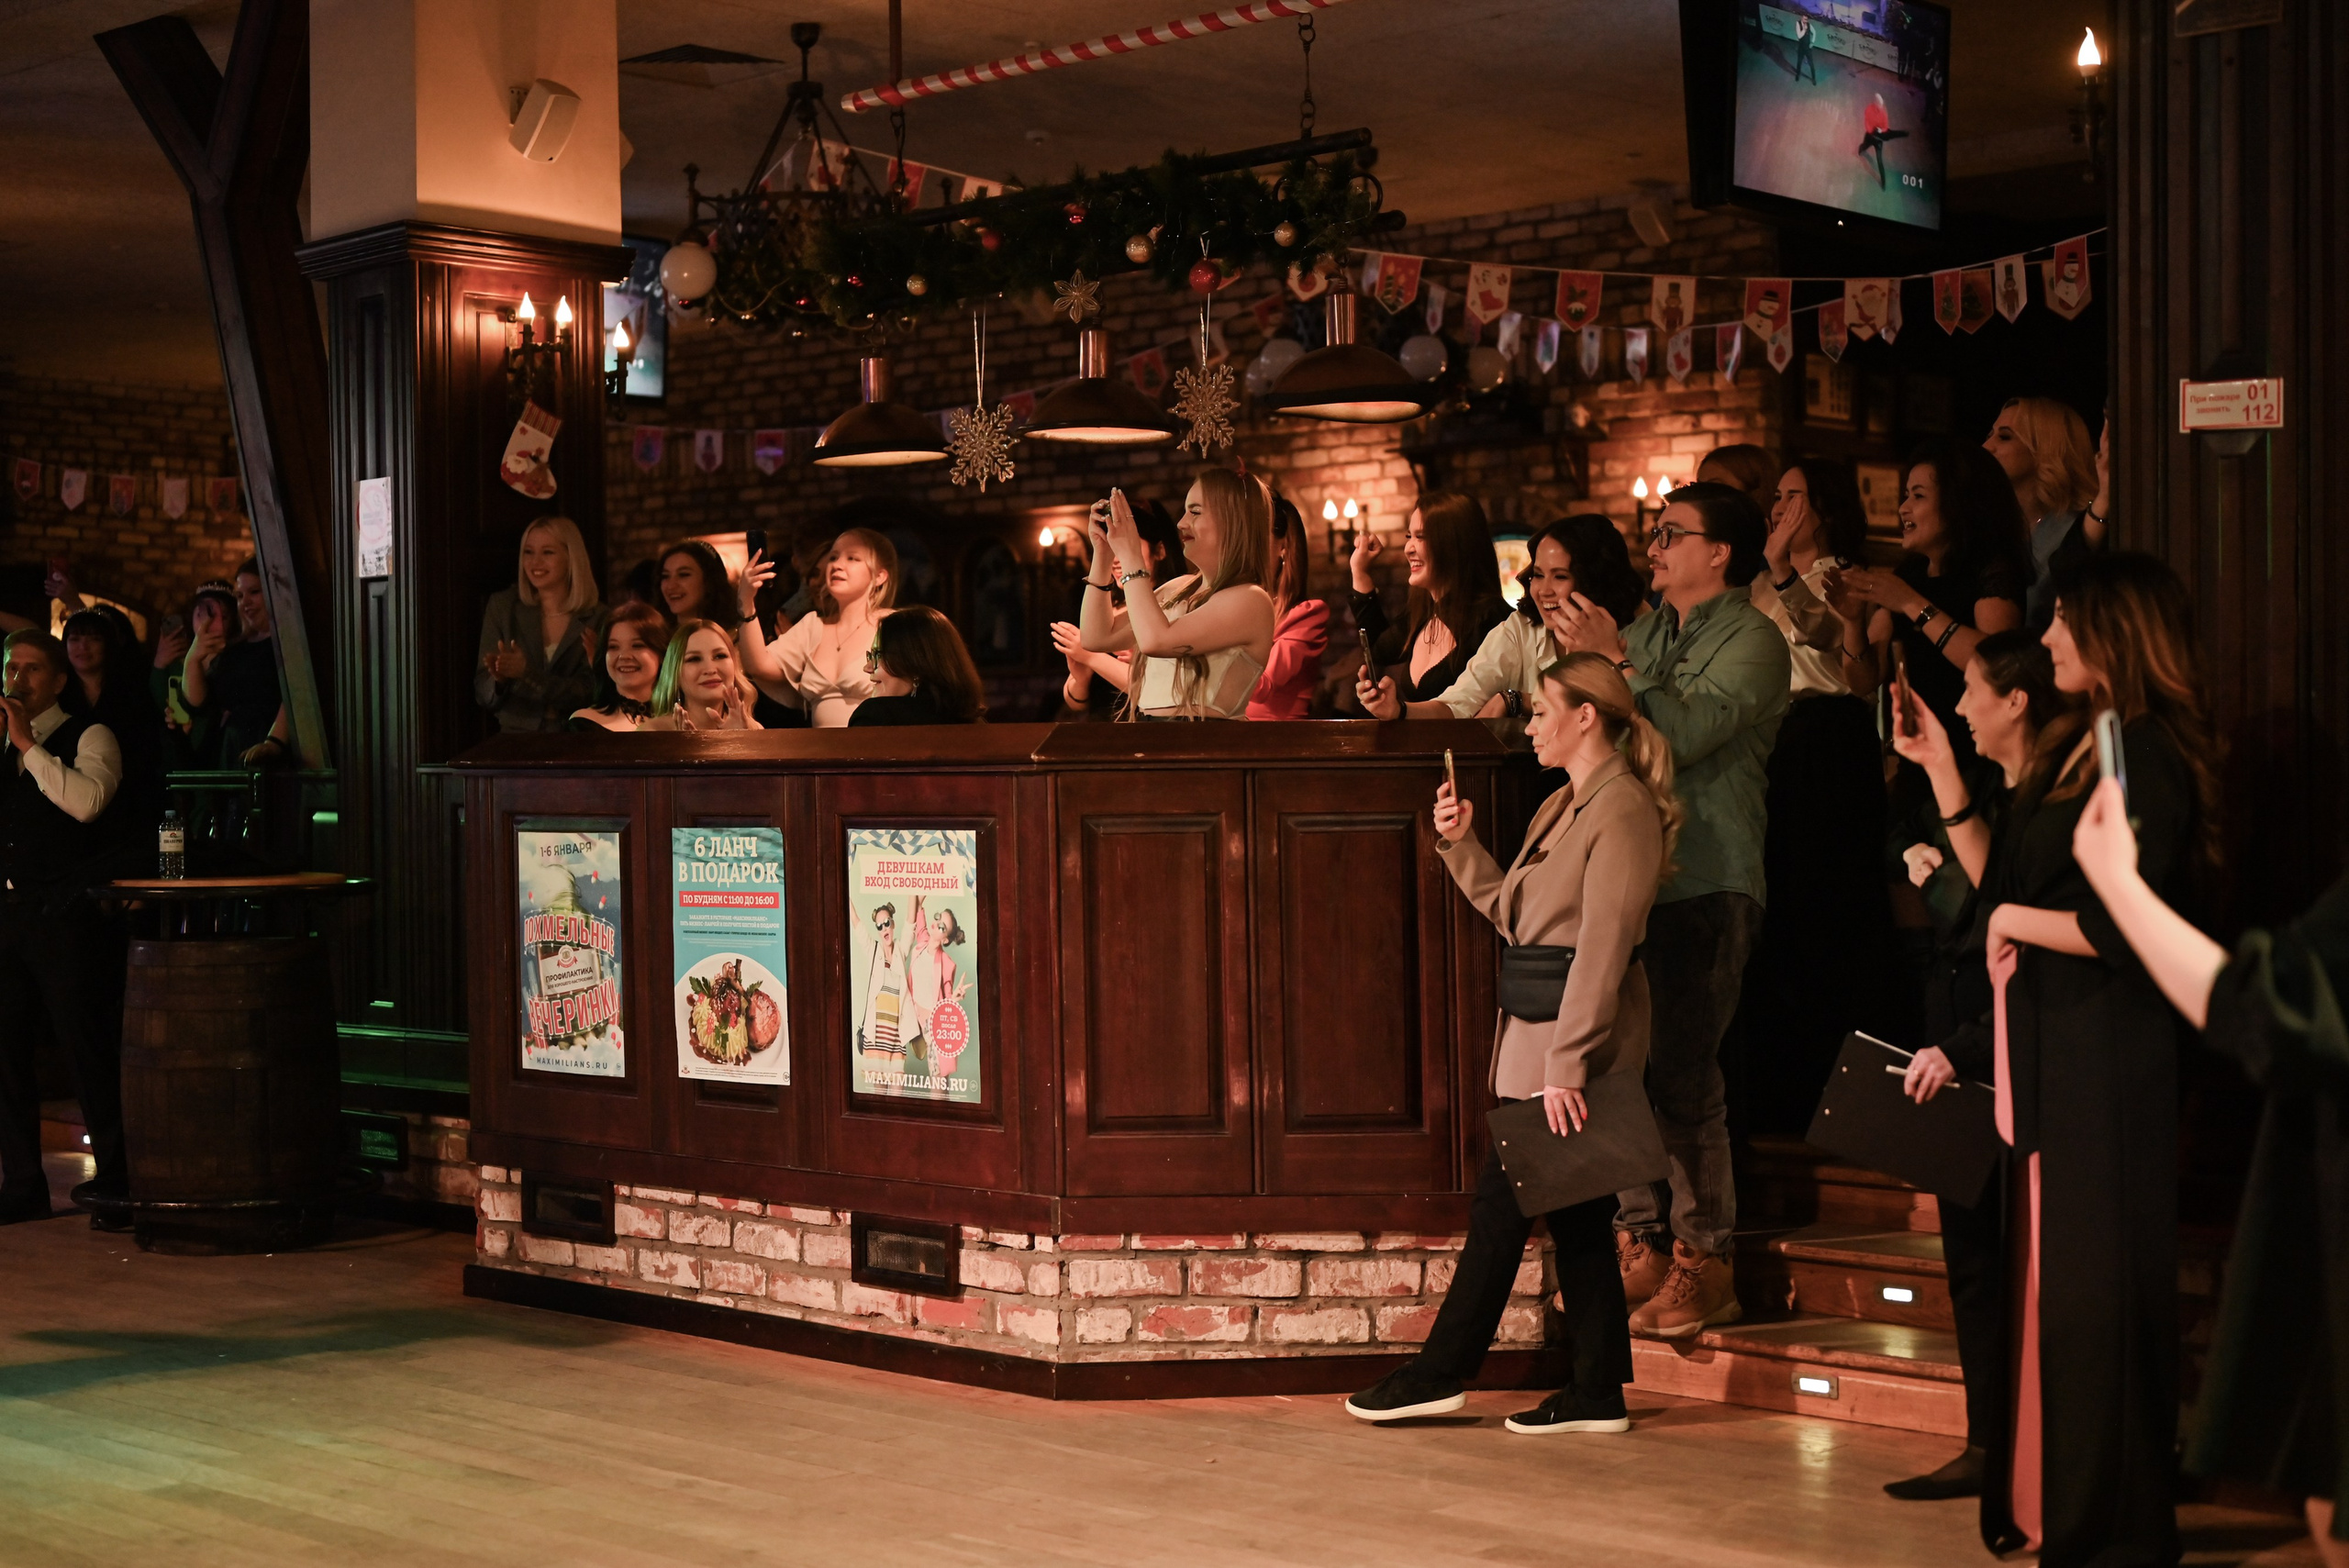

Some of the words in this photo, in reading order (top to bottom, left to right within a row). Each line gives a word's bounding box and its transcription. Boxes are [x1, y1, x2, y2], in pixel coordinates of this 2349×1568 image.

[1902, 174, 1923, 189] 001
[2190, 395, 2207, 404] При
[2209, 394, 2240, 402] пожаре
[2247, 384, 2268, 400] 01
[2242, 404, 2274, 421] 112
[540, 846, 551, 857] 1-6
[554, 842, 592, 856] ЯНВАРЯ
[695, 837, 706, 857] 6
[708, 837, 757, 857] ЛАНЧ
[679, 862, 688, 882] В
[691, 862, 779, 888] ПОДАРОК
[877, 862, 945, 875] ДЕВУШКАМ
[865, 876, 891, 889] ВХОД
[892, 876, 958, 890] СВОБОДНЫЙ
[683, 895, 693, 903] ПО
[694, 895, 723, 906] БУДНЯМ
[729, 896, 744, 905] 11:00
[744, 896, 754, 906] ДО
[755, 896, 774, 906] 16:00
[524, 915, 615, 957] ПОХМЕЛЬНЫЕ
[546, 967, 593, 983] ПРОФИЛАКТИКА
[529, 976, 618, 1035] ВЕЧЕРИНКИ
[936, 1029, 962, 1040] 23:00
[536, 1057, 608, 1069] MAXIMILIANS.RU
[865, 1071, 968, 1091] MAXIMILIANS.RU
